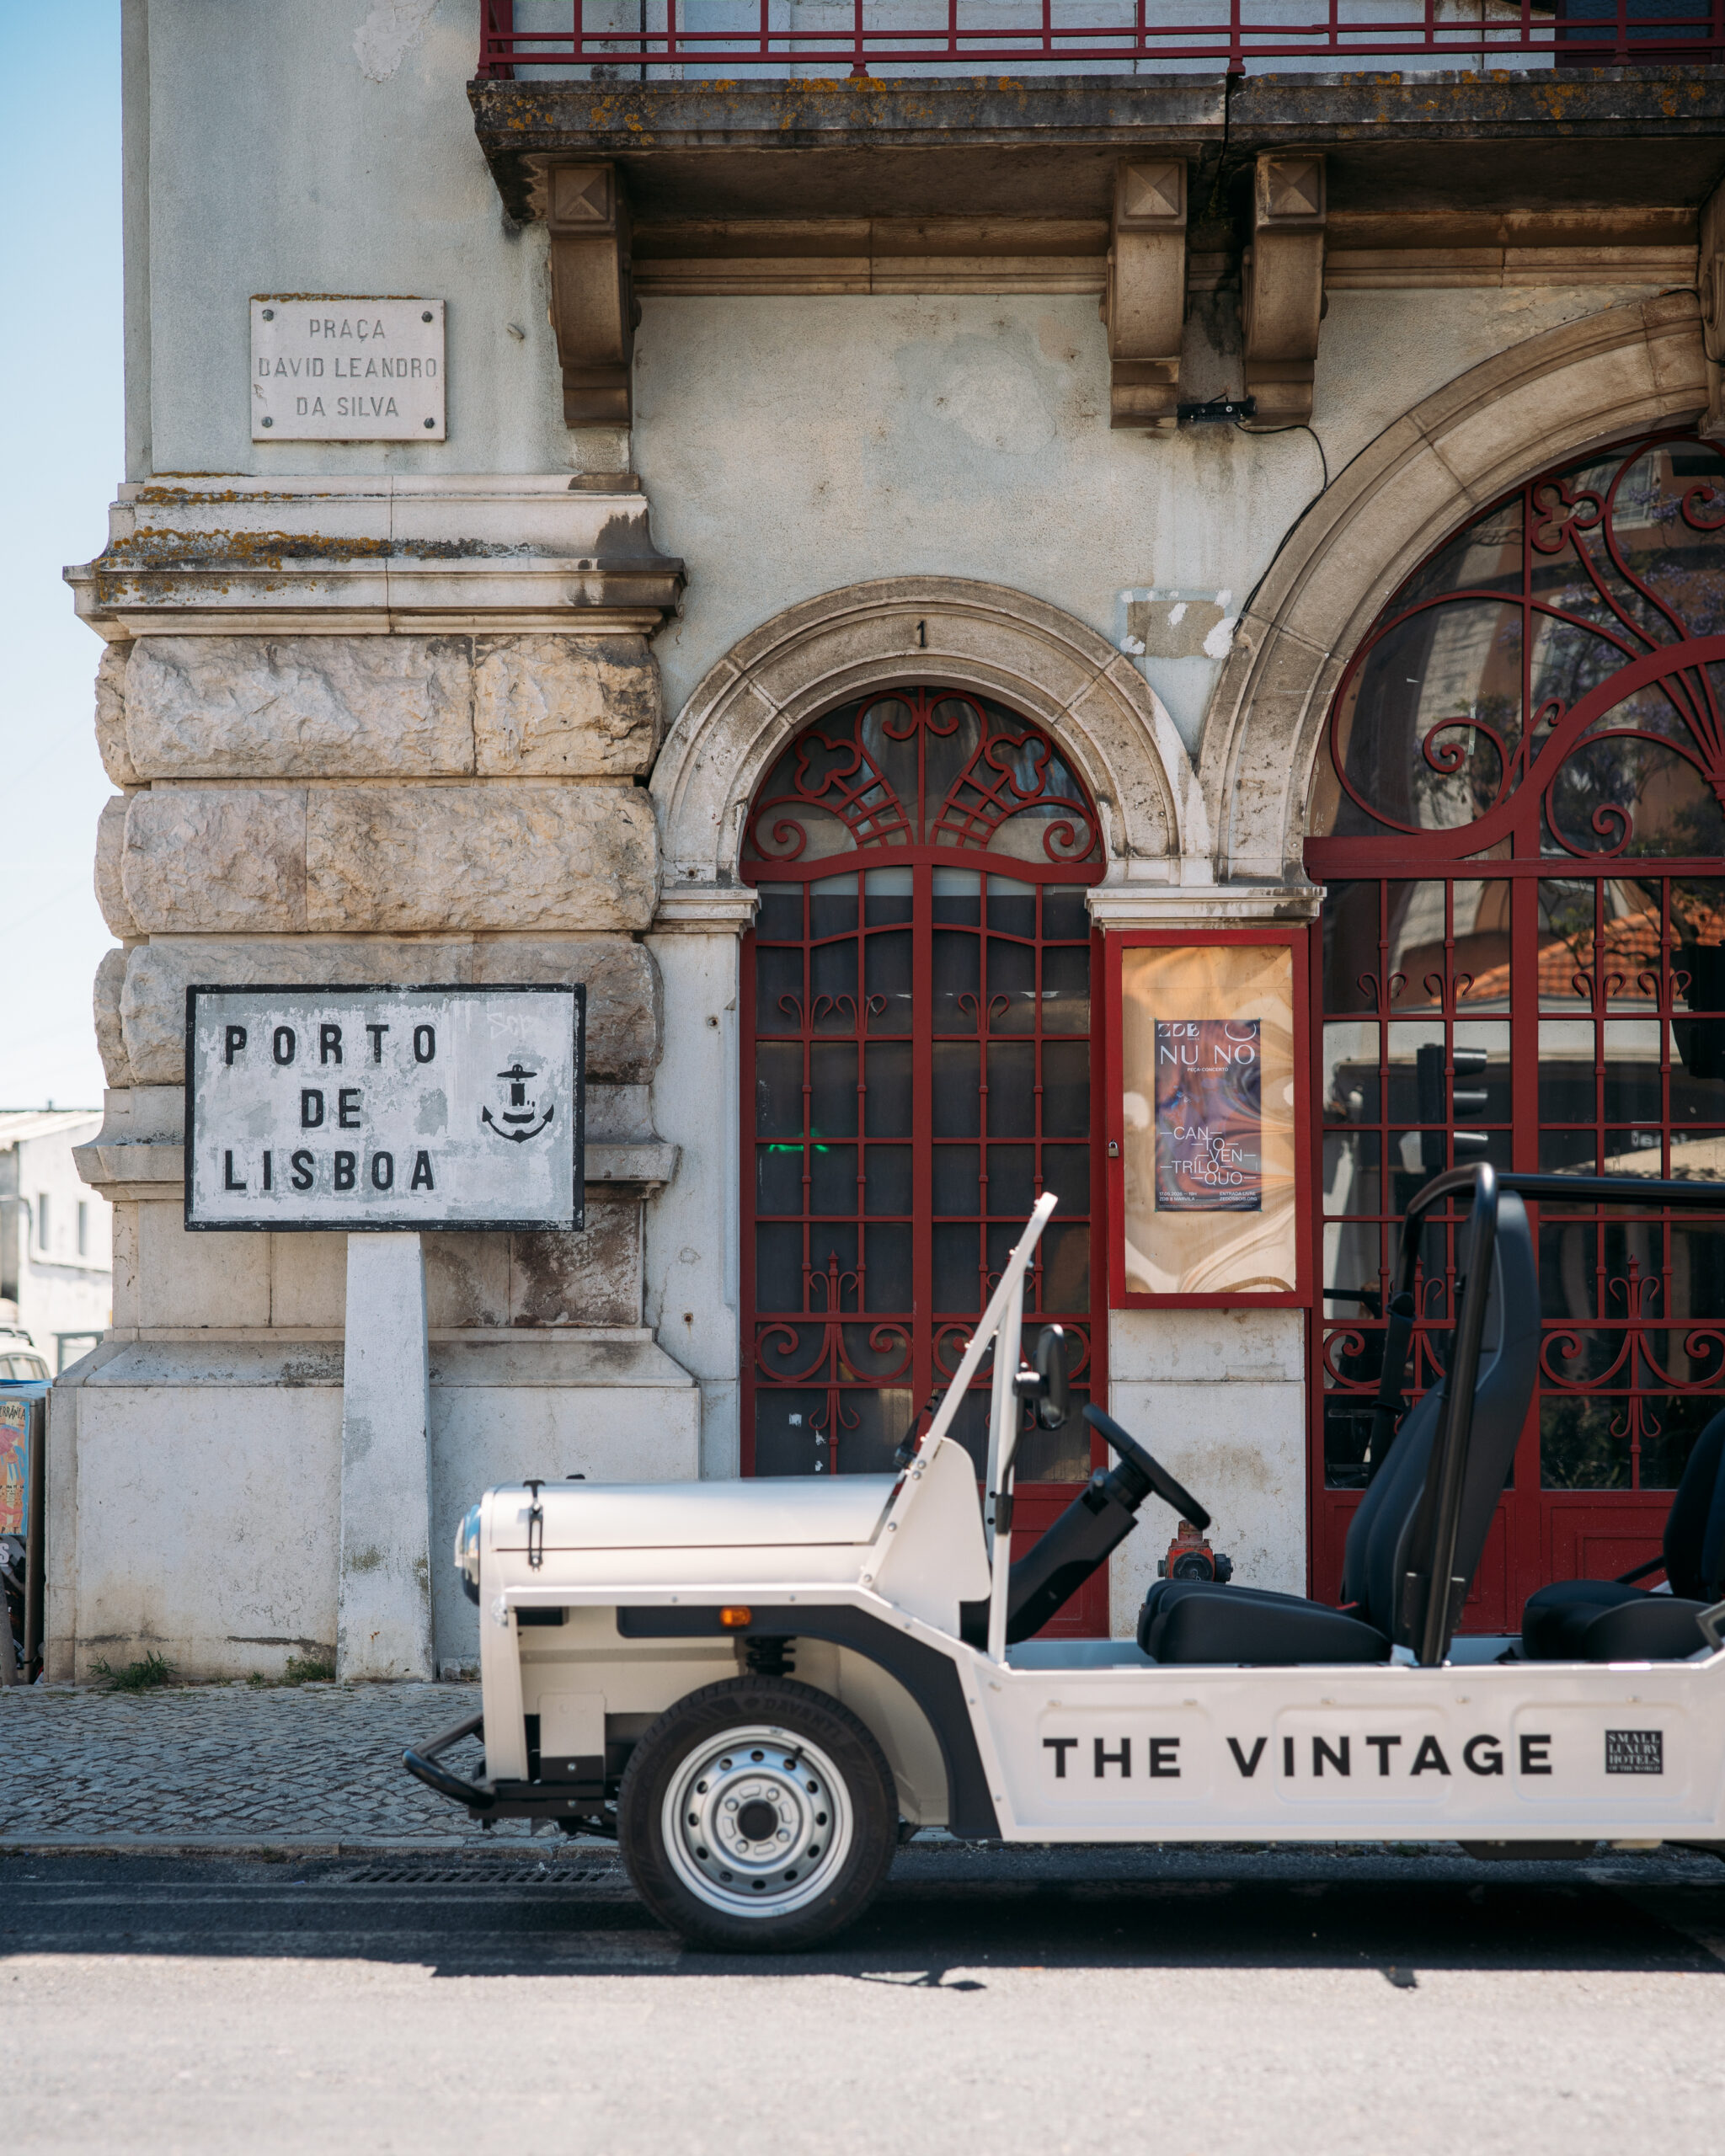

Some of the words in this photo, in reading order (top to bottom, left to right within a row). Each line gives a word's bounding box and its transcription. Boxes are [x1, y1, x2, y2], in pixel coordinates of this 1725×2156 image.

[309, 318, 386, 344] PRAÇA
[259, 357, 324, 378] DAVID
[335, 357, 437, 379] LEANDRO
[296, 397, 326, 417] DA
[337, 397, 399, 417] SILVA
[1158, 1023, 1200, 1038] ZDB
[224, 1023, 436, 1066] PORTO
[1160, 1044, 1199, 1065] NU
[1214, 1043, 1256, 1065] NO
[300, 1087, 361, 1129] DE
[224, 1149, 435, 1192] LISBOA
[1609, 1733, 1660, 1743] SMALL
[1609, 1744, 1658, 1754] LUXURY
[1042, 1737, 1181, 1779] THE
[1226, 1732, 1553, 1778] VINTAGE
[1609, 1754, 1660, 1765] HOTELS
